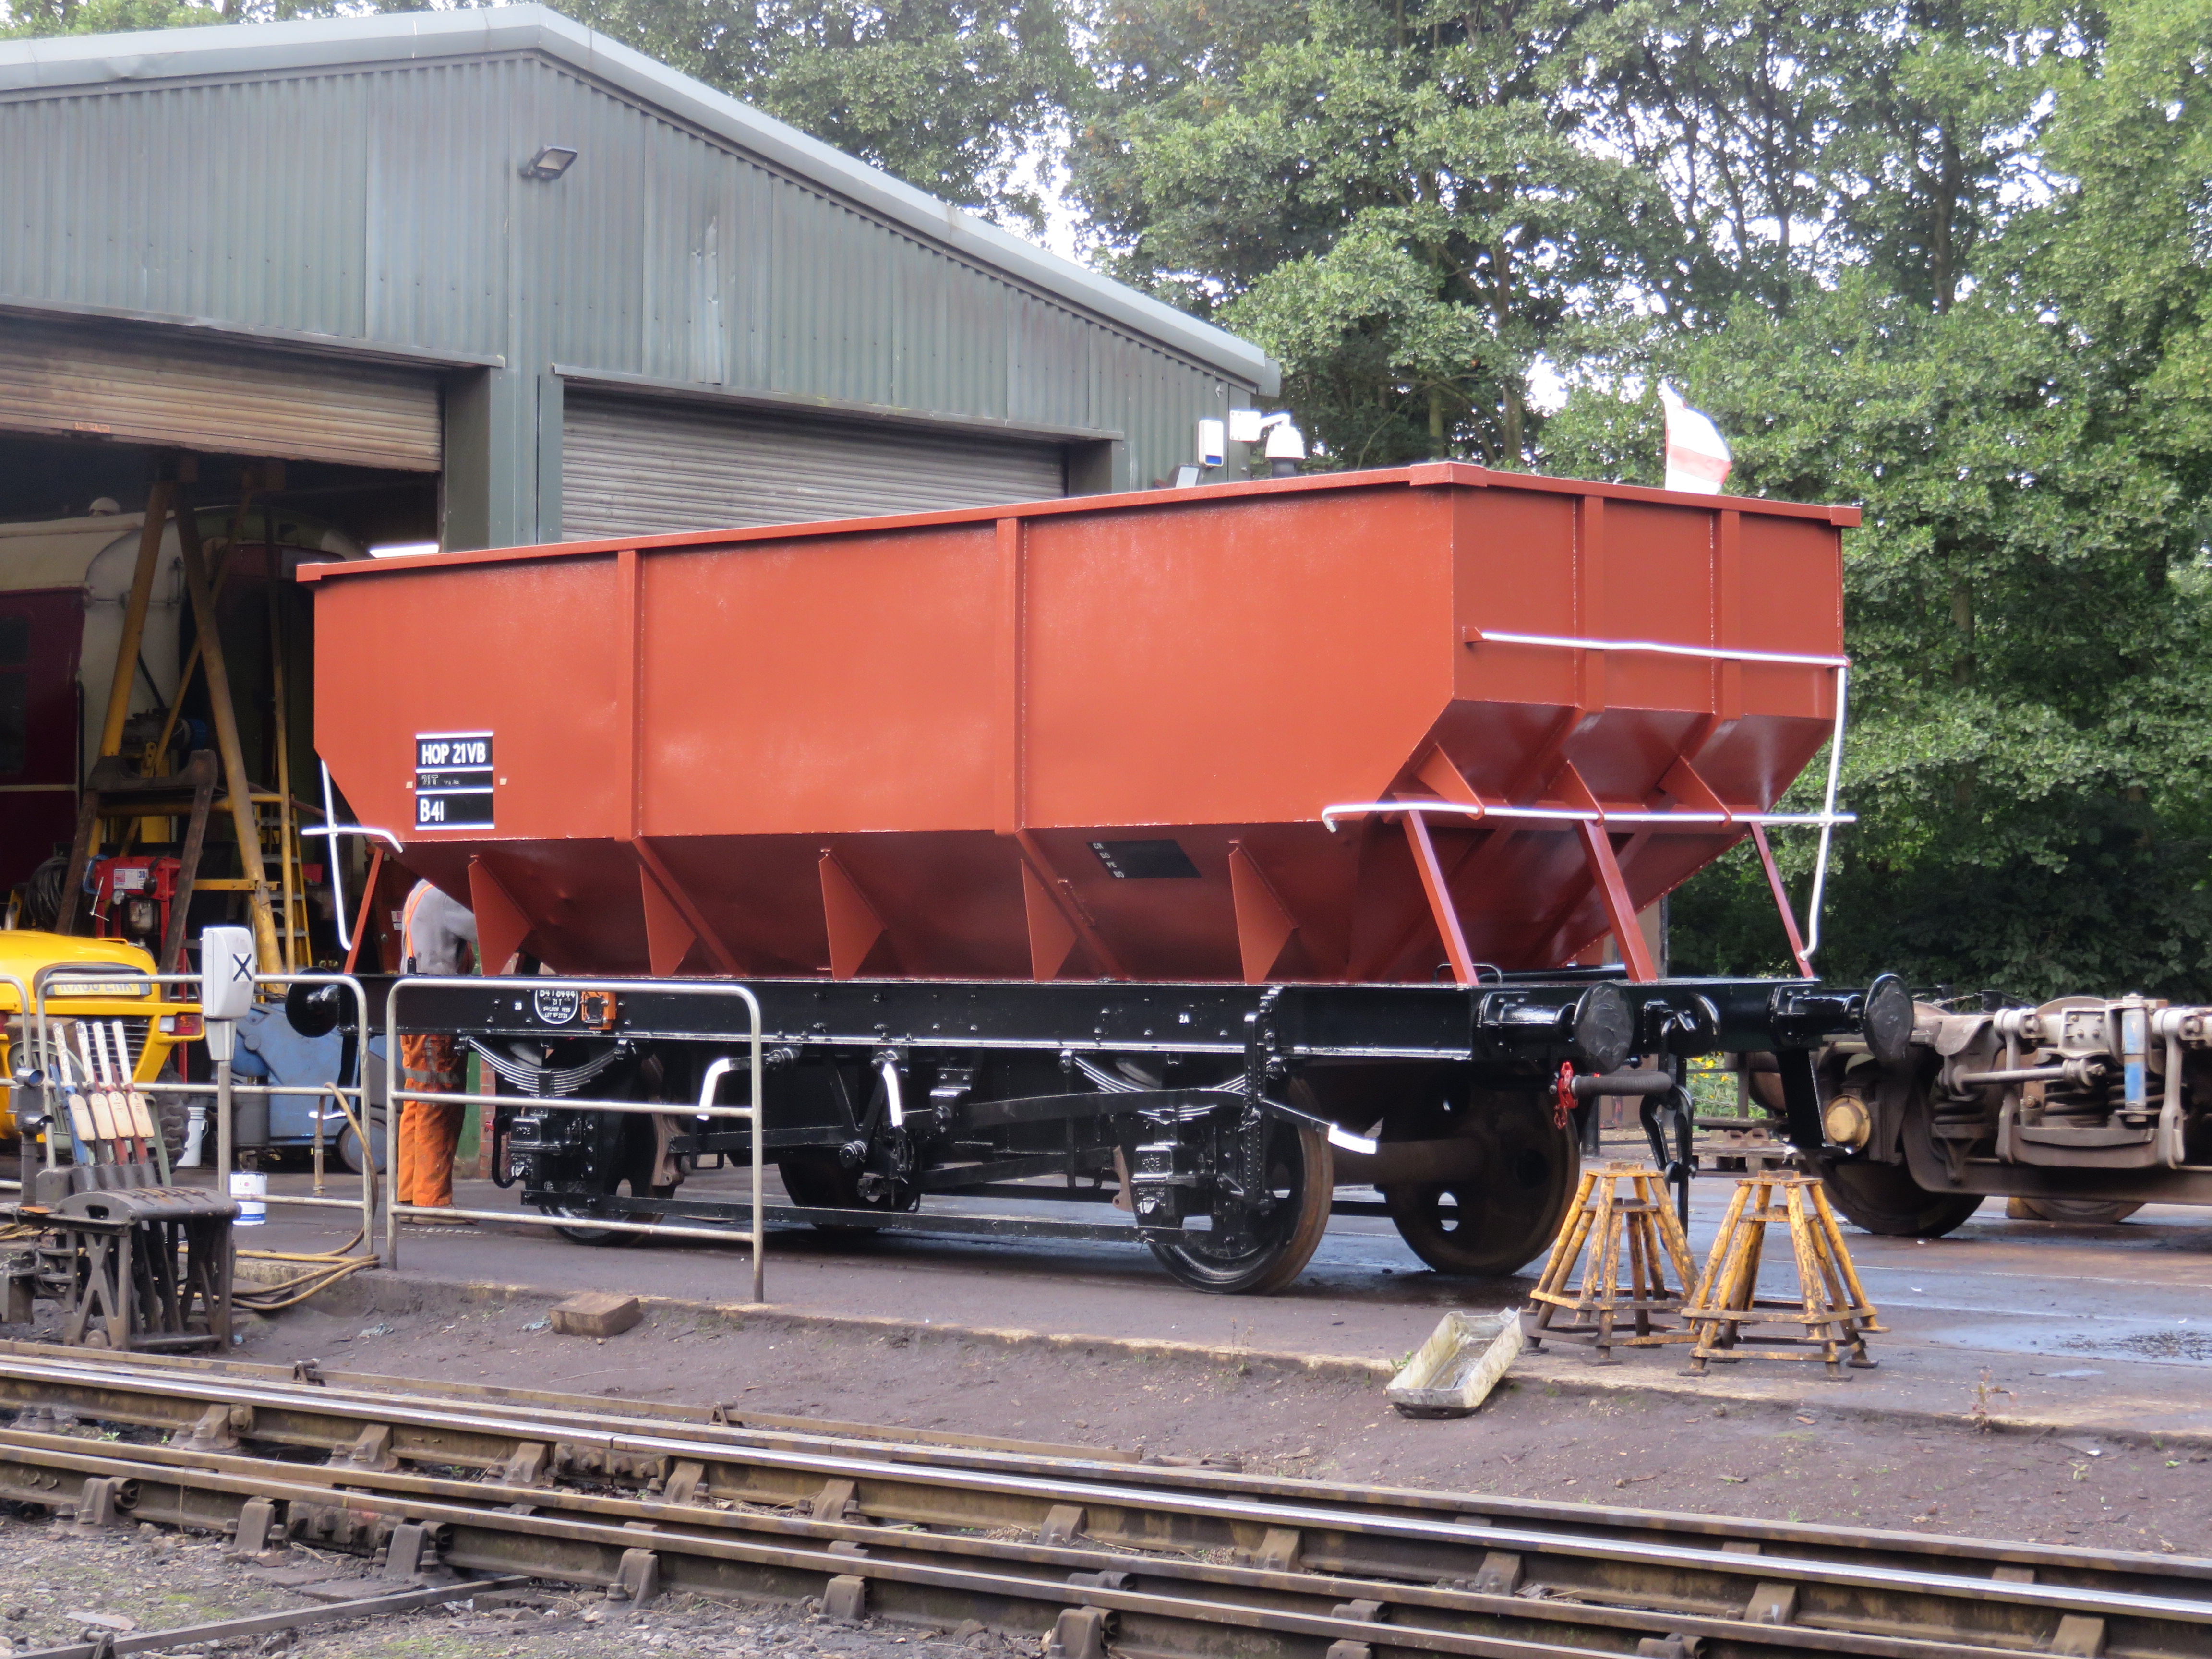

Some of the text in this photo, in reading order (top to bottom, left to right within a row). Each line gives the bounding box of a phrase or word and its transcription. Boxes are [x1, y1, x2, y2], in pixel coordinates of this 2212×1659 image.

[421, 743, 486, 765] HOP 21VB
[1179, 1014, 1189, 1023] 2A
